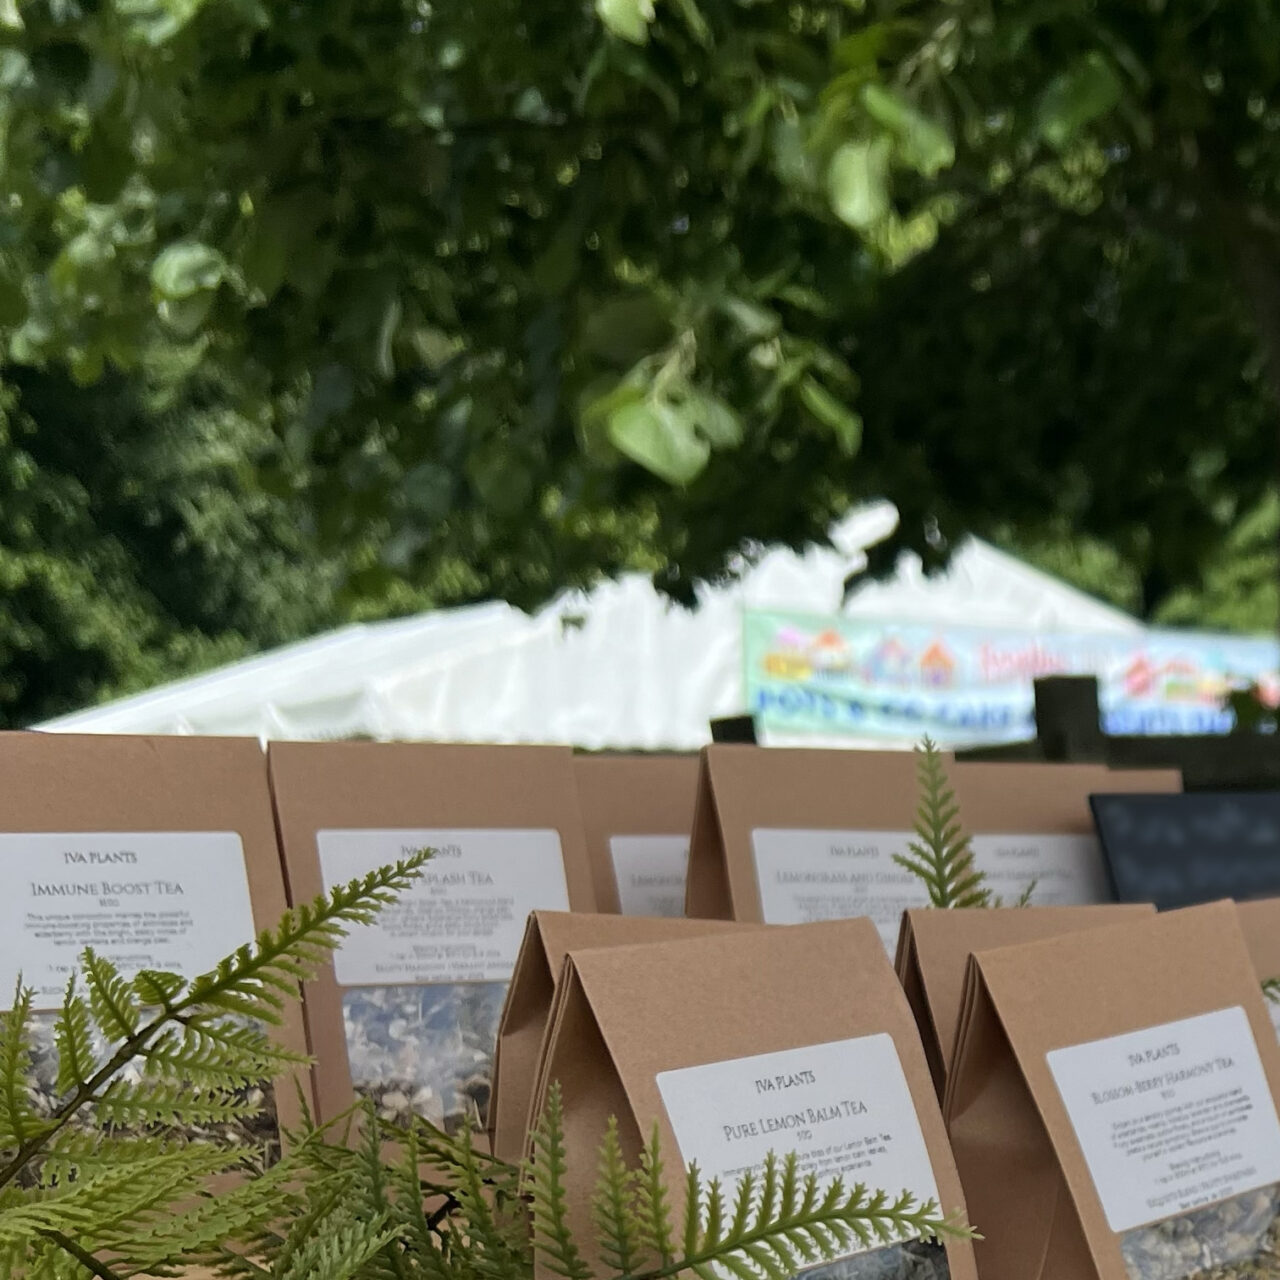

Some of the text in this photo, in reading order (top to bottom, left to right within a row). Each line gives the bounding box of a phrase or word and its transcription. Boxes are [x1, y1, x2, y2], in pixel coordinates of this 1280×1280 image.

[64, 850, 137, 864] IVA PLANTS
[469, 870, 494, 885] TEA
[31, 880, 184, 896] IMMUNE BOOST TEA
[755, 1070, 816, 1094] IVA PLANTS
[723, 1099, 867, 1142] PURE LEMON BALM TEA
